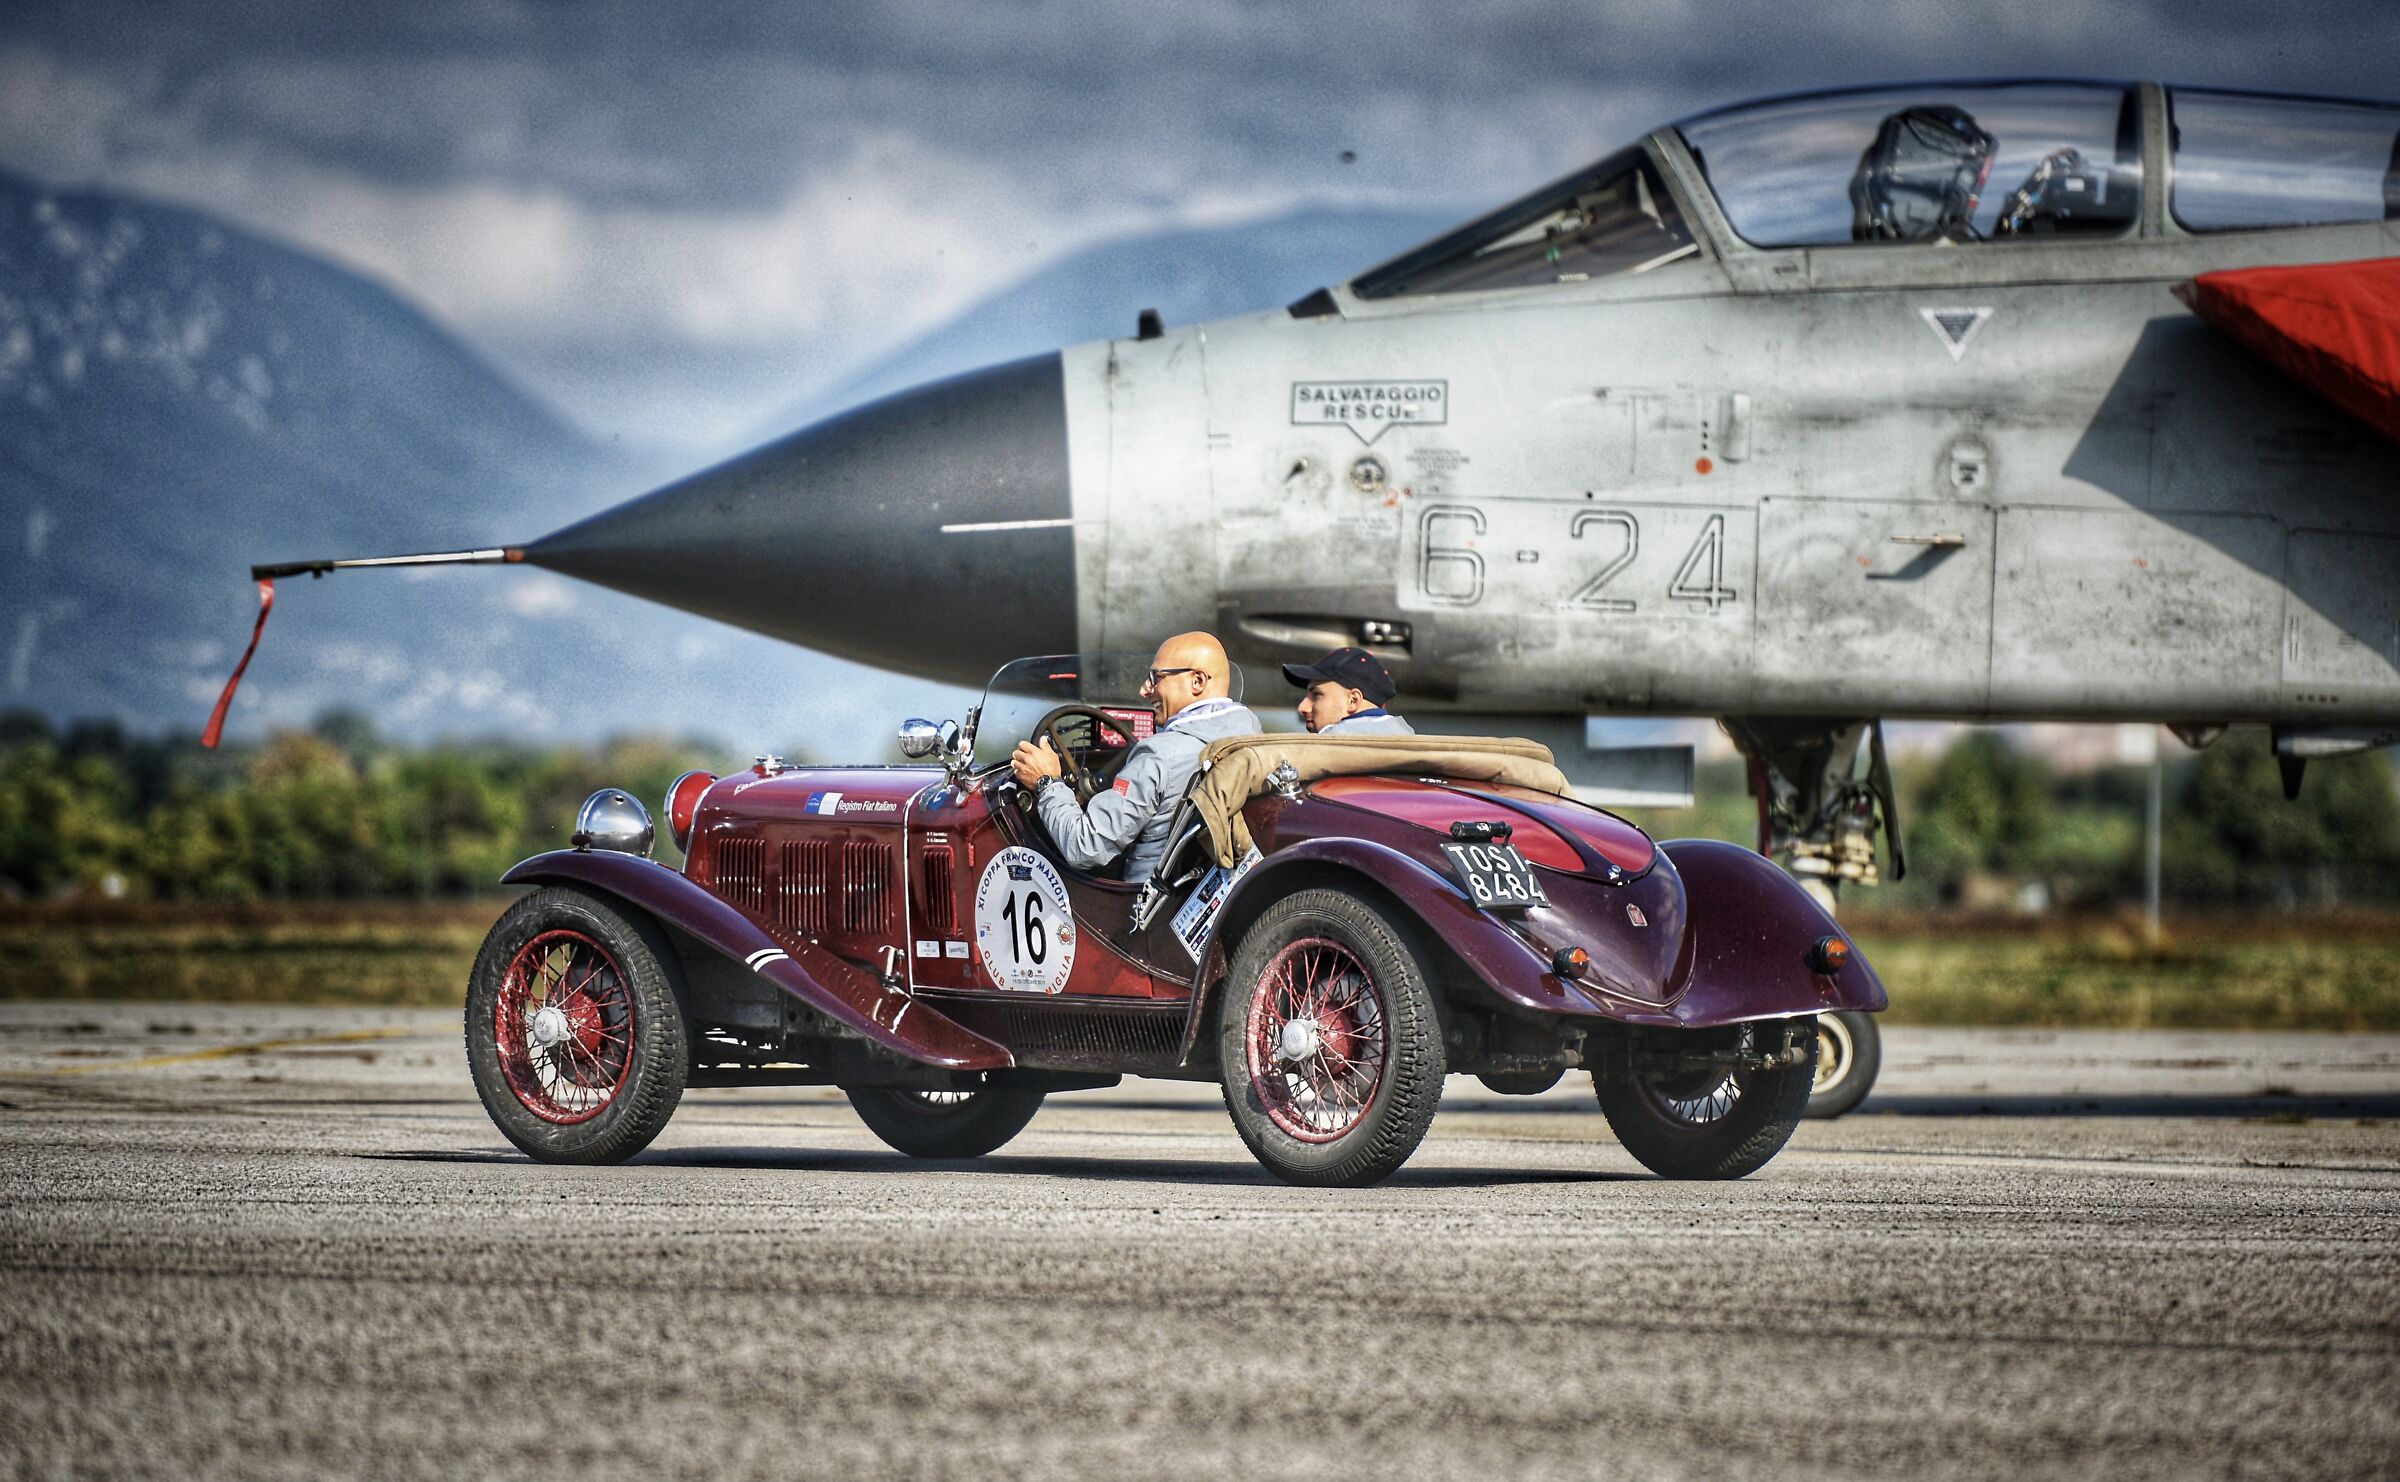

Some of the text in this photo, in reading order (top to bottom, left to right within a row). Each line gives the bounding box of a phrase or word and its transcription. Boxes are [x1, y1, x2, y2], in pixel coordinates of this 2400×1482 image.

[1300, 387, 1441, 402] SALVATAGGIO
[837, 799, 897, 814] Registro Fiat Italiano
[1001, 852, 1036, 866] FRANCO
[981, 863, 1001, 895] COPPA
[1469, 873, 1546, 902] 8484
[978, 899, 986, 910] XI
[1002, 890, 1047, 965] 16
[984, 950, 1006, 987] CLUB
